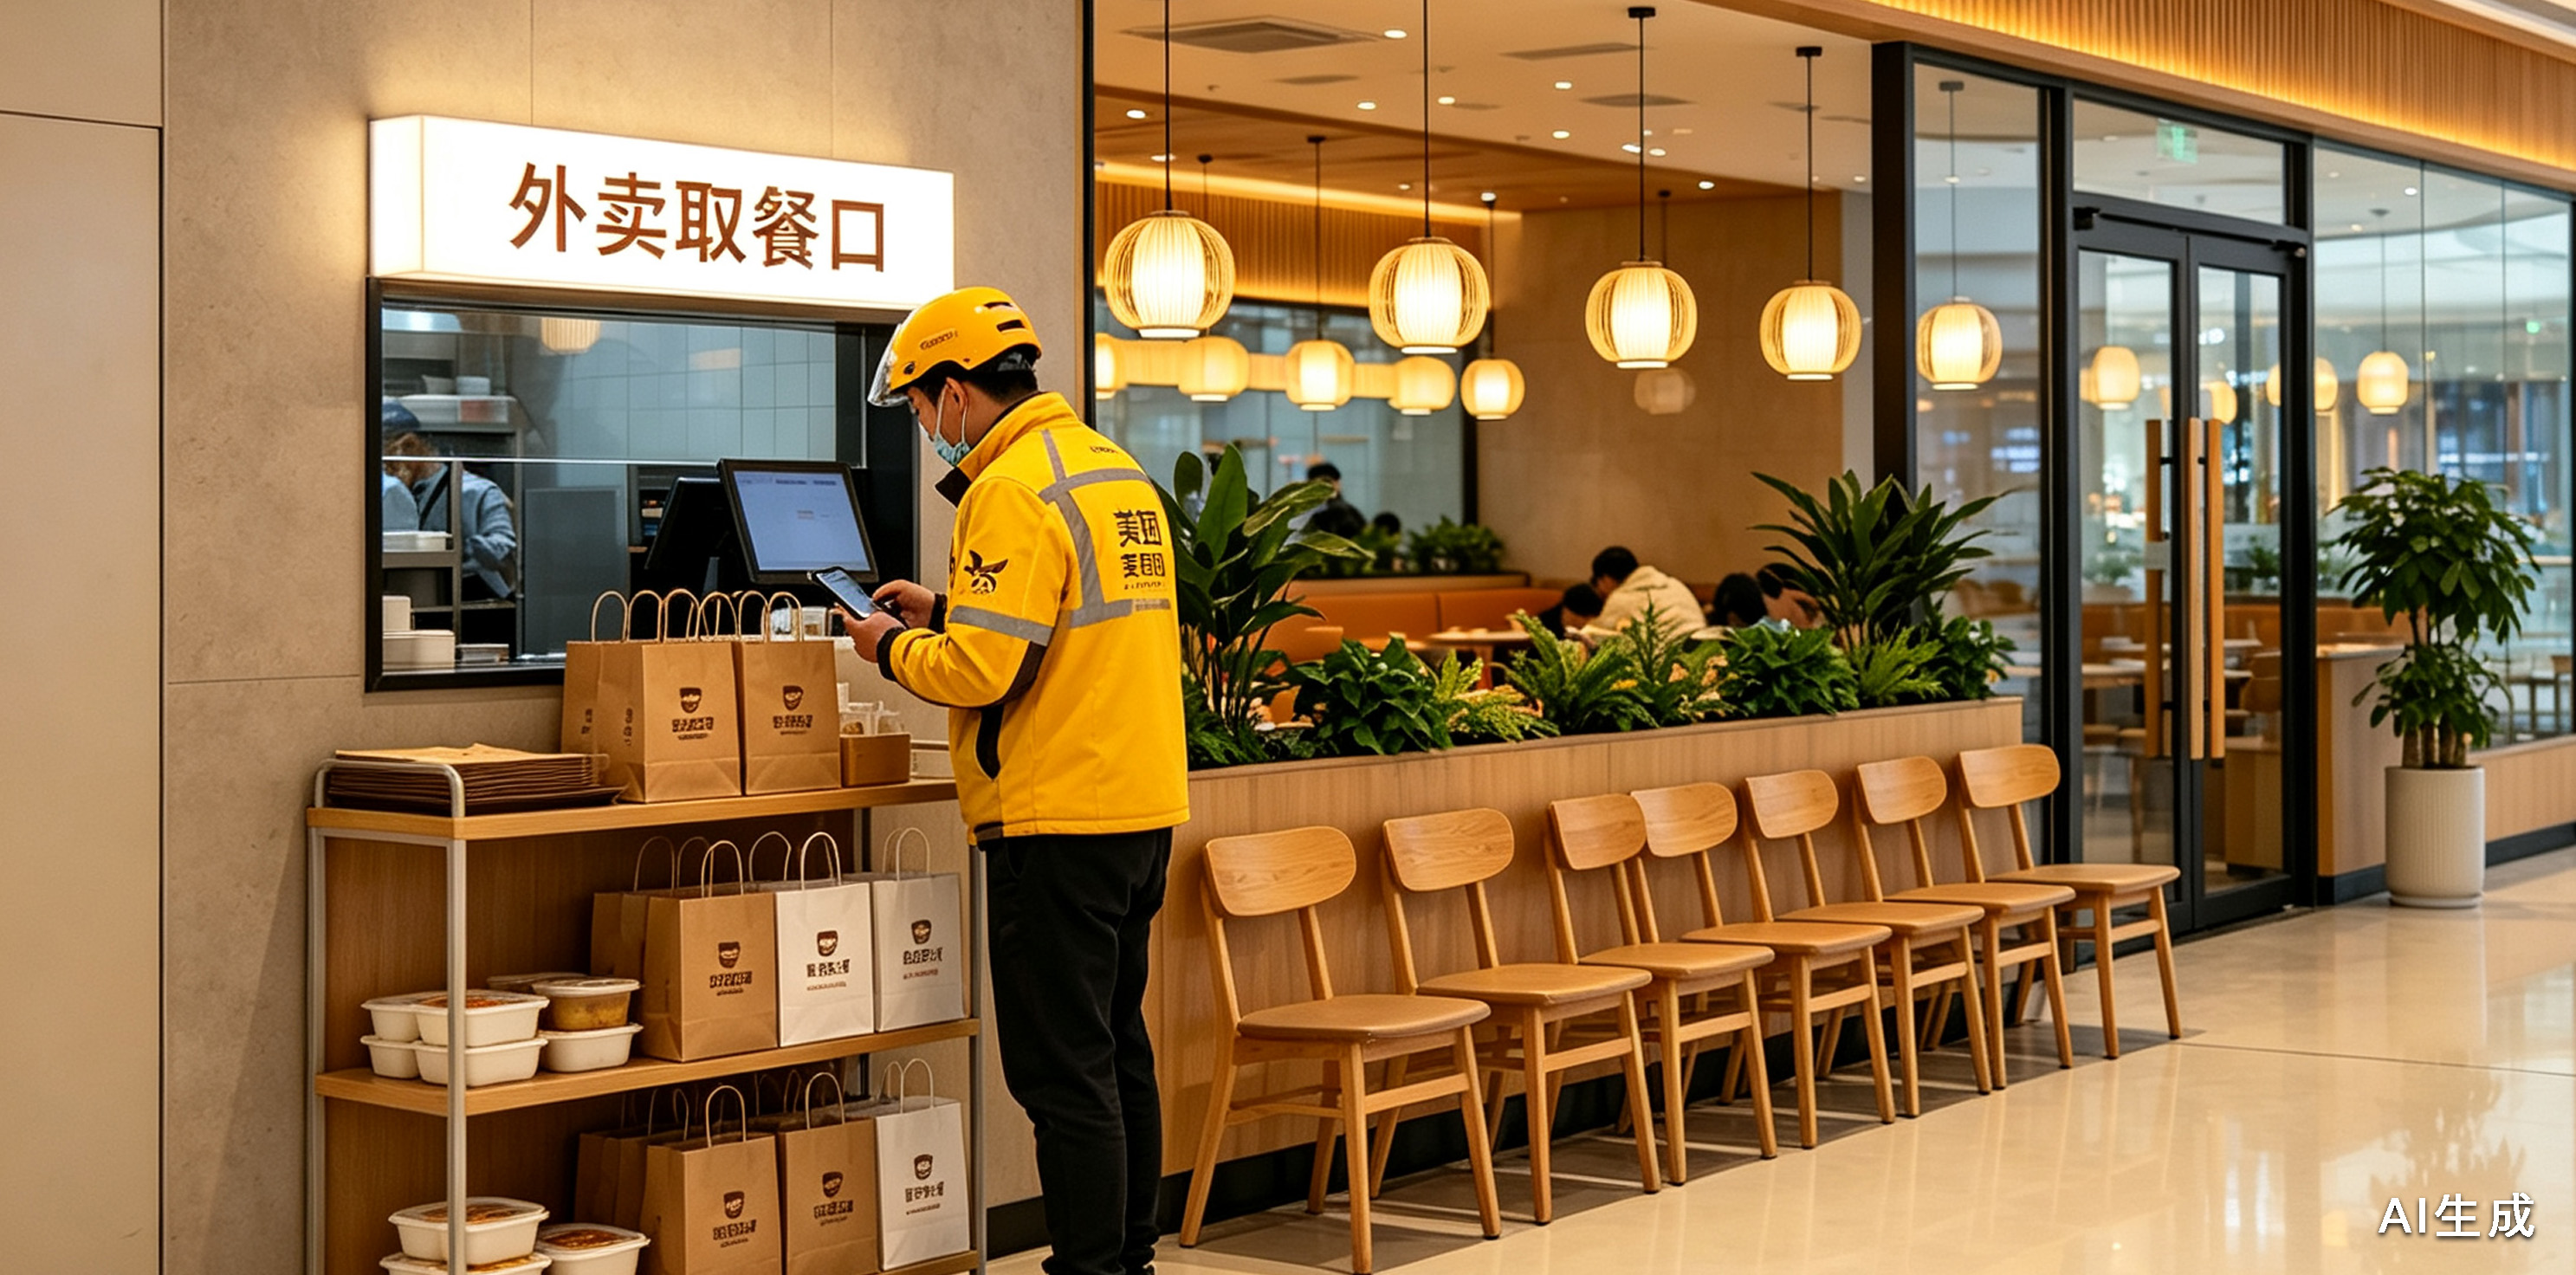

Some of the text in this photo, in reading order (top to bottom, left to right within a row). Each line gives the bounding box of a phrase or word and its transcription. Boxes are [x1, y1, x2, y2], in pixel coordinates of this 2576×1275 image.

[508, 162, 885, 273] 外卖取餐口
